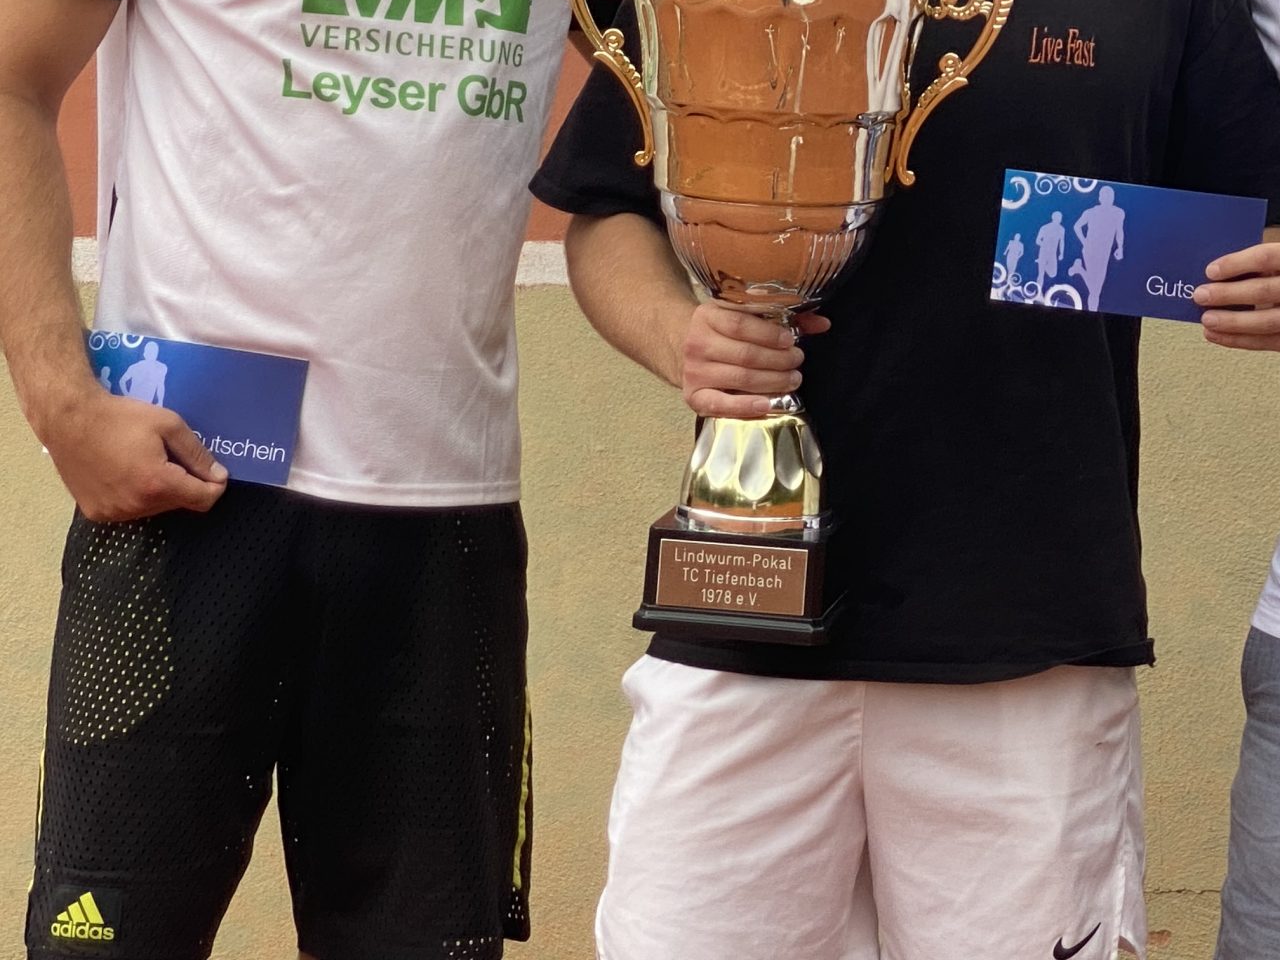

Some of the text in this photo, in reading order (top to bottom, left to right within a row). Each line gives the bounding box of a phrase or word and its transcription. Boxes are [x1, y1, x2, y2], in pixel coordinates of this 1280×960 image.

[300, 23, 524, 67] VERSICHERUNG
[1028, 26, 1095, 67] Live Fast
[282, 58, 527, 123] Leyser GbR
[192, 430, 287, 462] utschein
[674, 547, 792, 571] Lindwurm-Pokal
[682, 567, 783, 589] TC Tiefenbach
[701, 588, 732, 604] 1978
[51, 920, 114, 940] adidas
